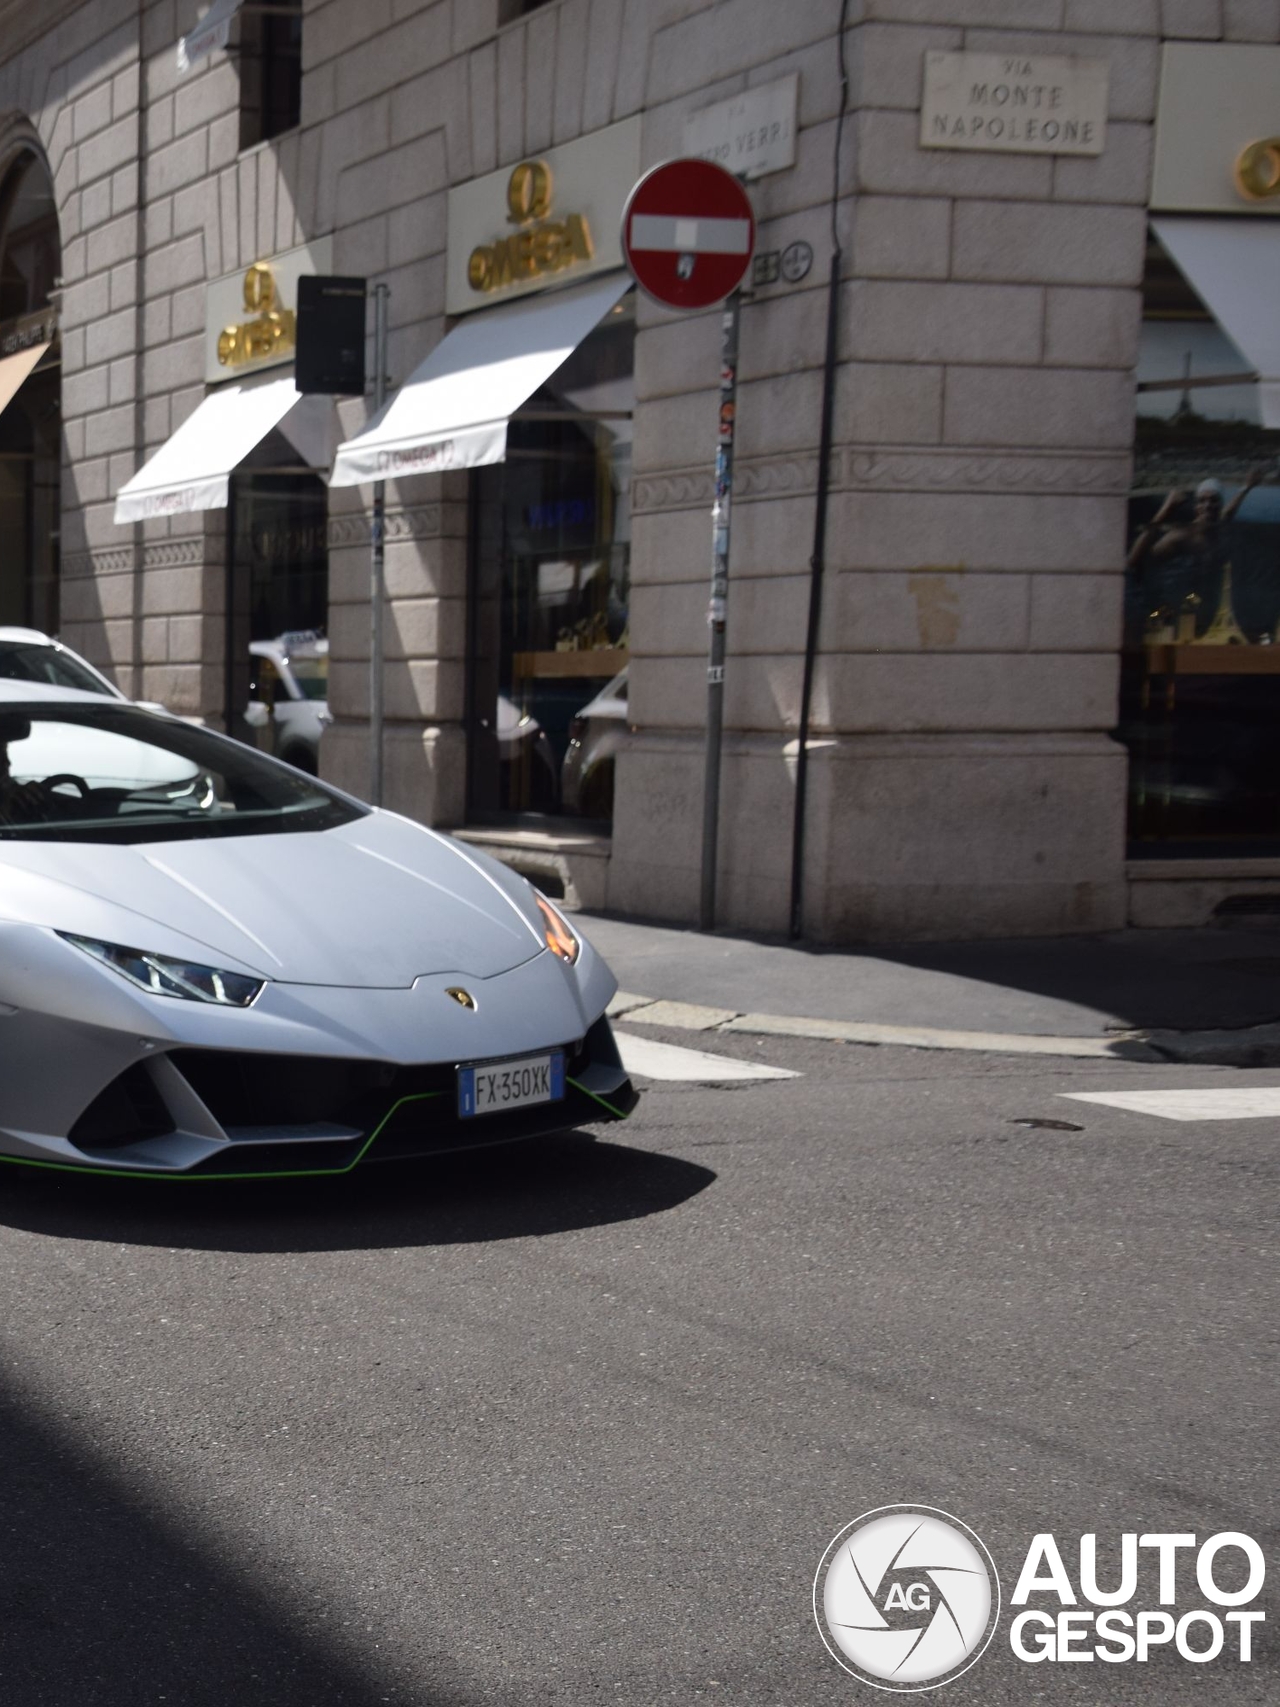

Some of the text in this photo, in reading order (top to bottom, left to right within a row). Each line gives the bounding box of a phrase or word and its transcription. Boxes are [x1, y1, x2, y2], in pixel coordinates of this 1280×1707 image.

[1003, 59, 1033, 76] VIA
[968, 83, 1063, 110] MONTE
[734, 119, 789, 155] VERRI
[931, 113, 1095, 145] NAPOLEONE
[468, 213, 594, 293] OMEGA
